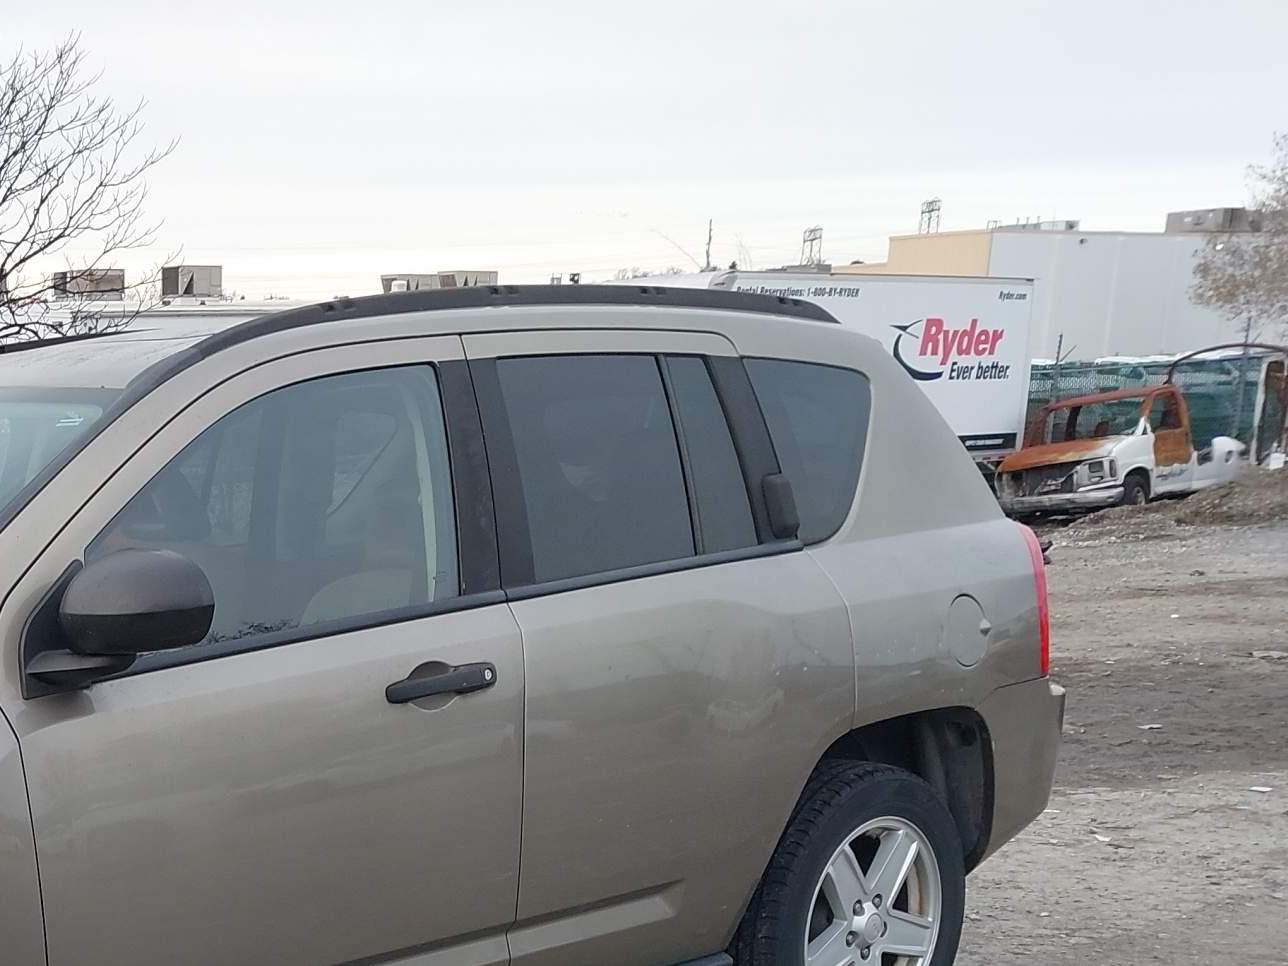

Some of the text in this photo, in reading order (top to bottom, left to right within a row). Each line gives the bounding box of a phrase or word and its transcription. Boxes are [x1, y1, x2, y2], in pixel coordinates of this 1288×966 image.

[807, 287, 860, 297] 1-800-BY-RYDER
[998, 290, 1028, 301] Ryder.com
[919, 318, 1004, 365] Ryder
[948, 360, 1010, 380] Ever better.
